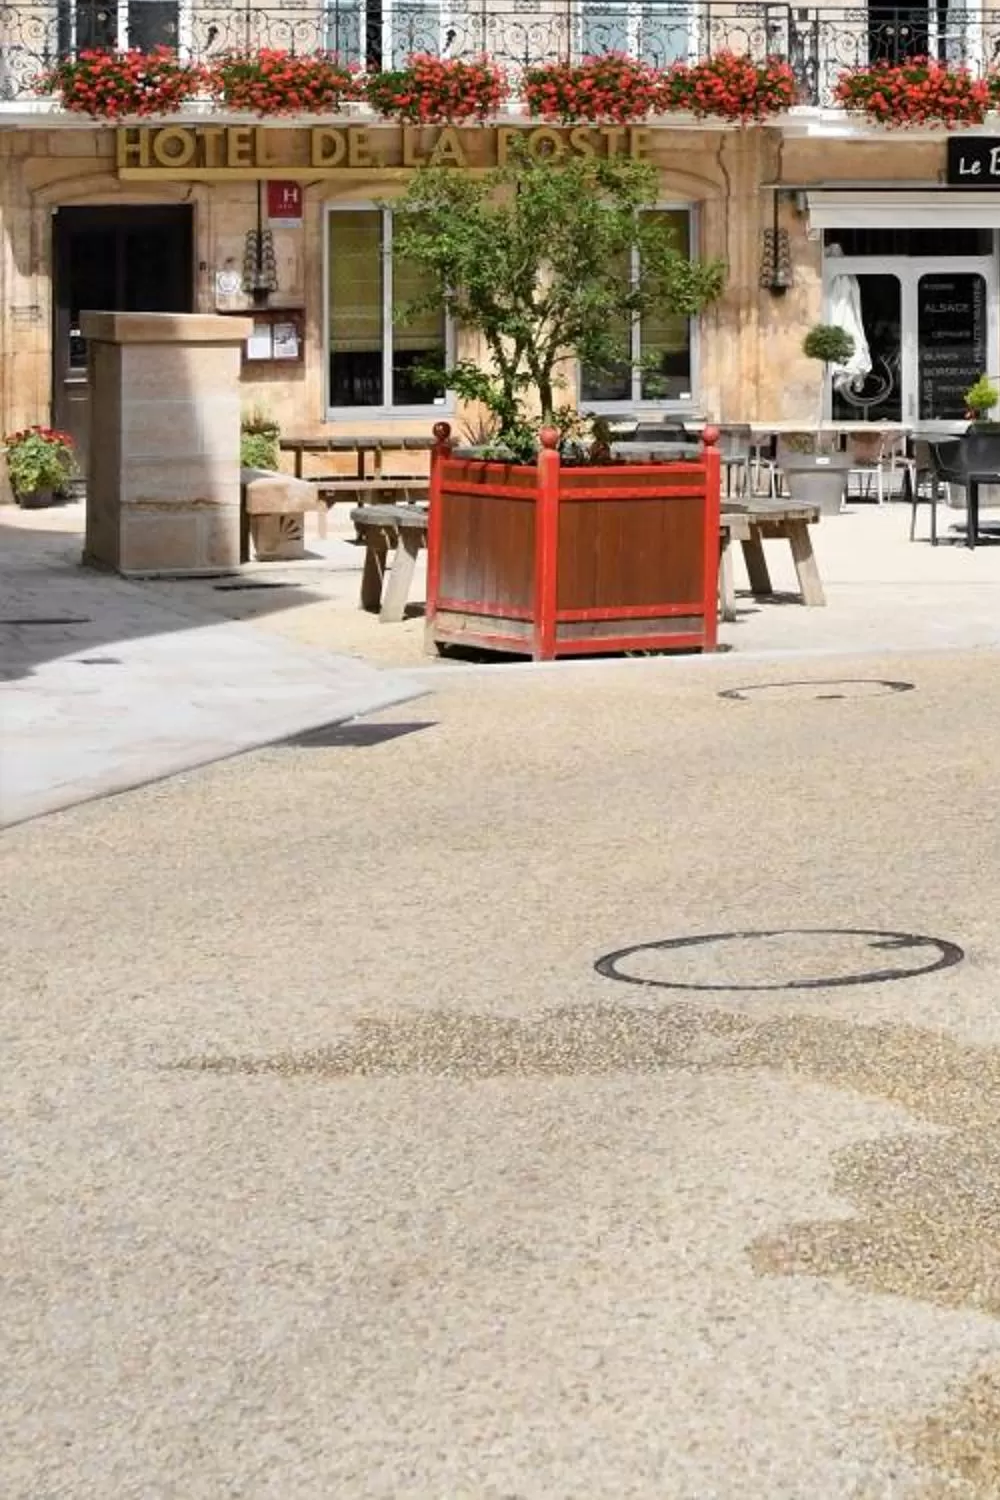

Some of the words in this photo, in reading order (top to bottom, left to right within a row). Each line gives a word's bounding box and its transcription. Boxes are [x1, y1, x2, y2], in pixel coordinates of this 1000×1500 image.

[117, 126, 274, 168] HOTEL
[311, 127, 372, 168] DE
[403, 126, 468, 168] LA
[497, 126, 652, 169] POSTE
[959, 157, 982, 176] Le
[282, 187, 299, 204] H
